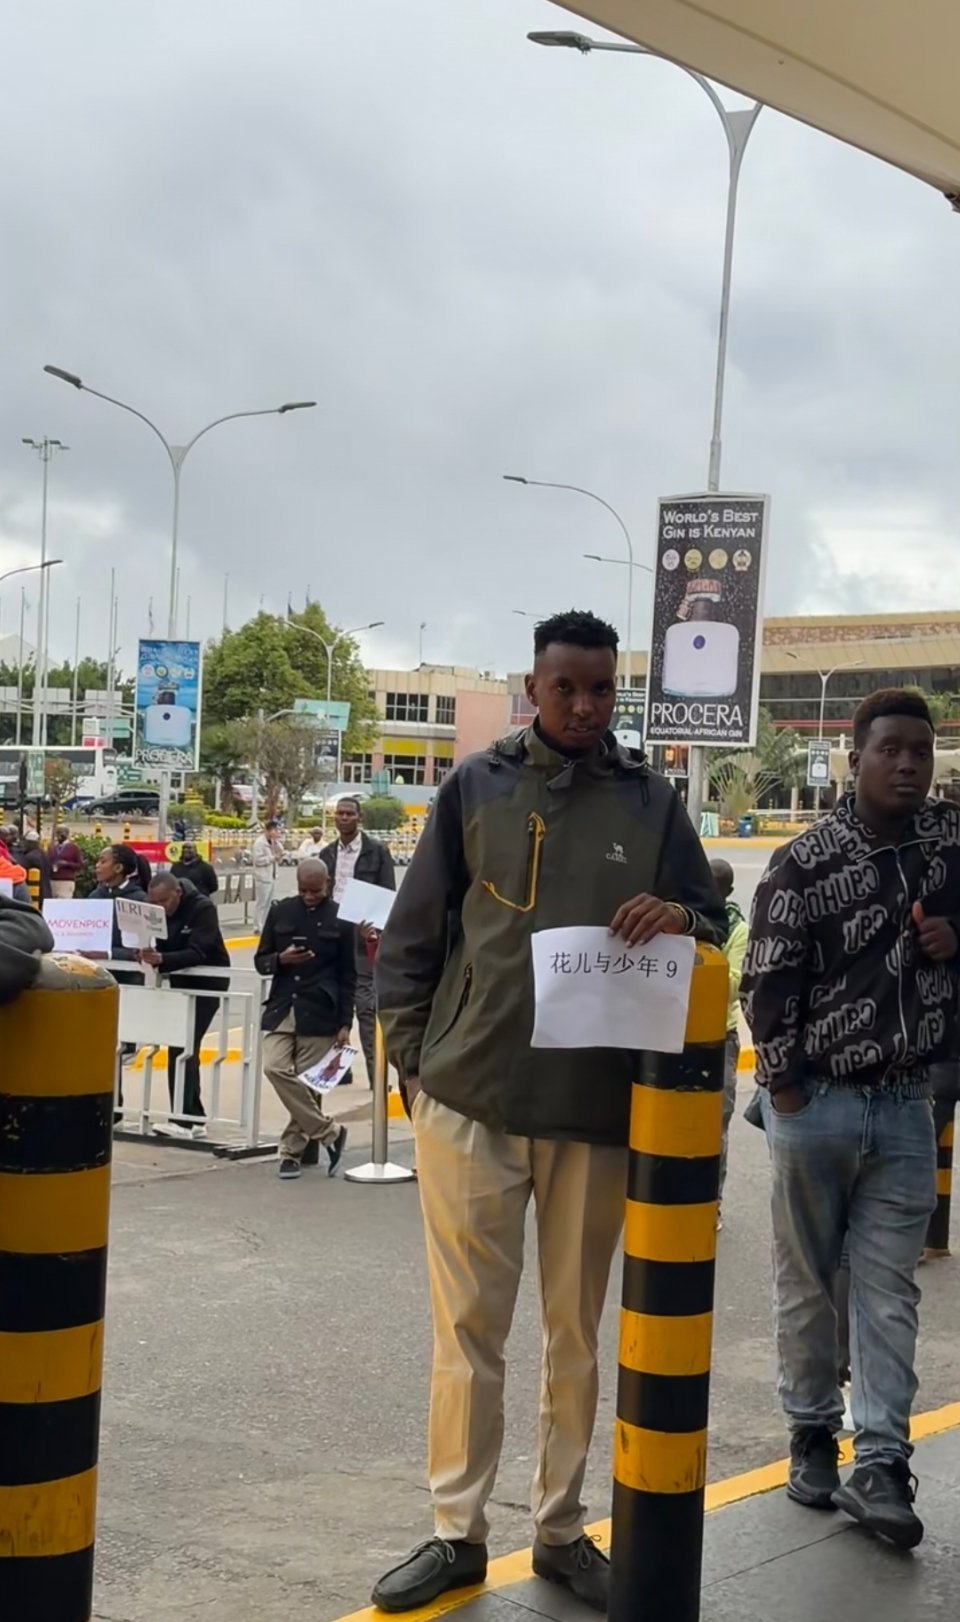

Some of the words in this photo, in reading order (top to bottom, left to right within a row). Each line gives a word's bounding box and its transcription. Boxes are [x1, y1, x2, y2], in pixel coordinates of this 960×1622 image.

[663, 509, 719, 524] WORLD'S
[723, 509, 758, 522] BEST
[663, 525, 685, 539] GIN
[689, 528, 700, 538] IS
[703, 524, 756, 538] KENYAN
[651, 702, 743, 727] PROCERA
[650, 727, 692, 736] EQUATORIAL
[694, 728, 727, 737] AFRICAN
[728, 729, 743, 738] GIN
[550, 952, 659, 978] 花儿与少年
[666, 960, 678, 978] 9
